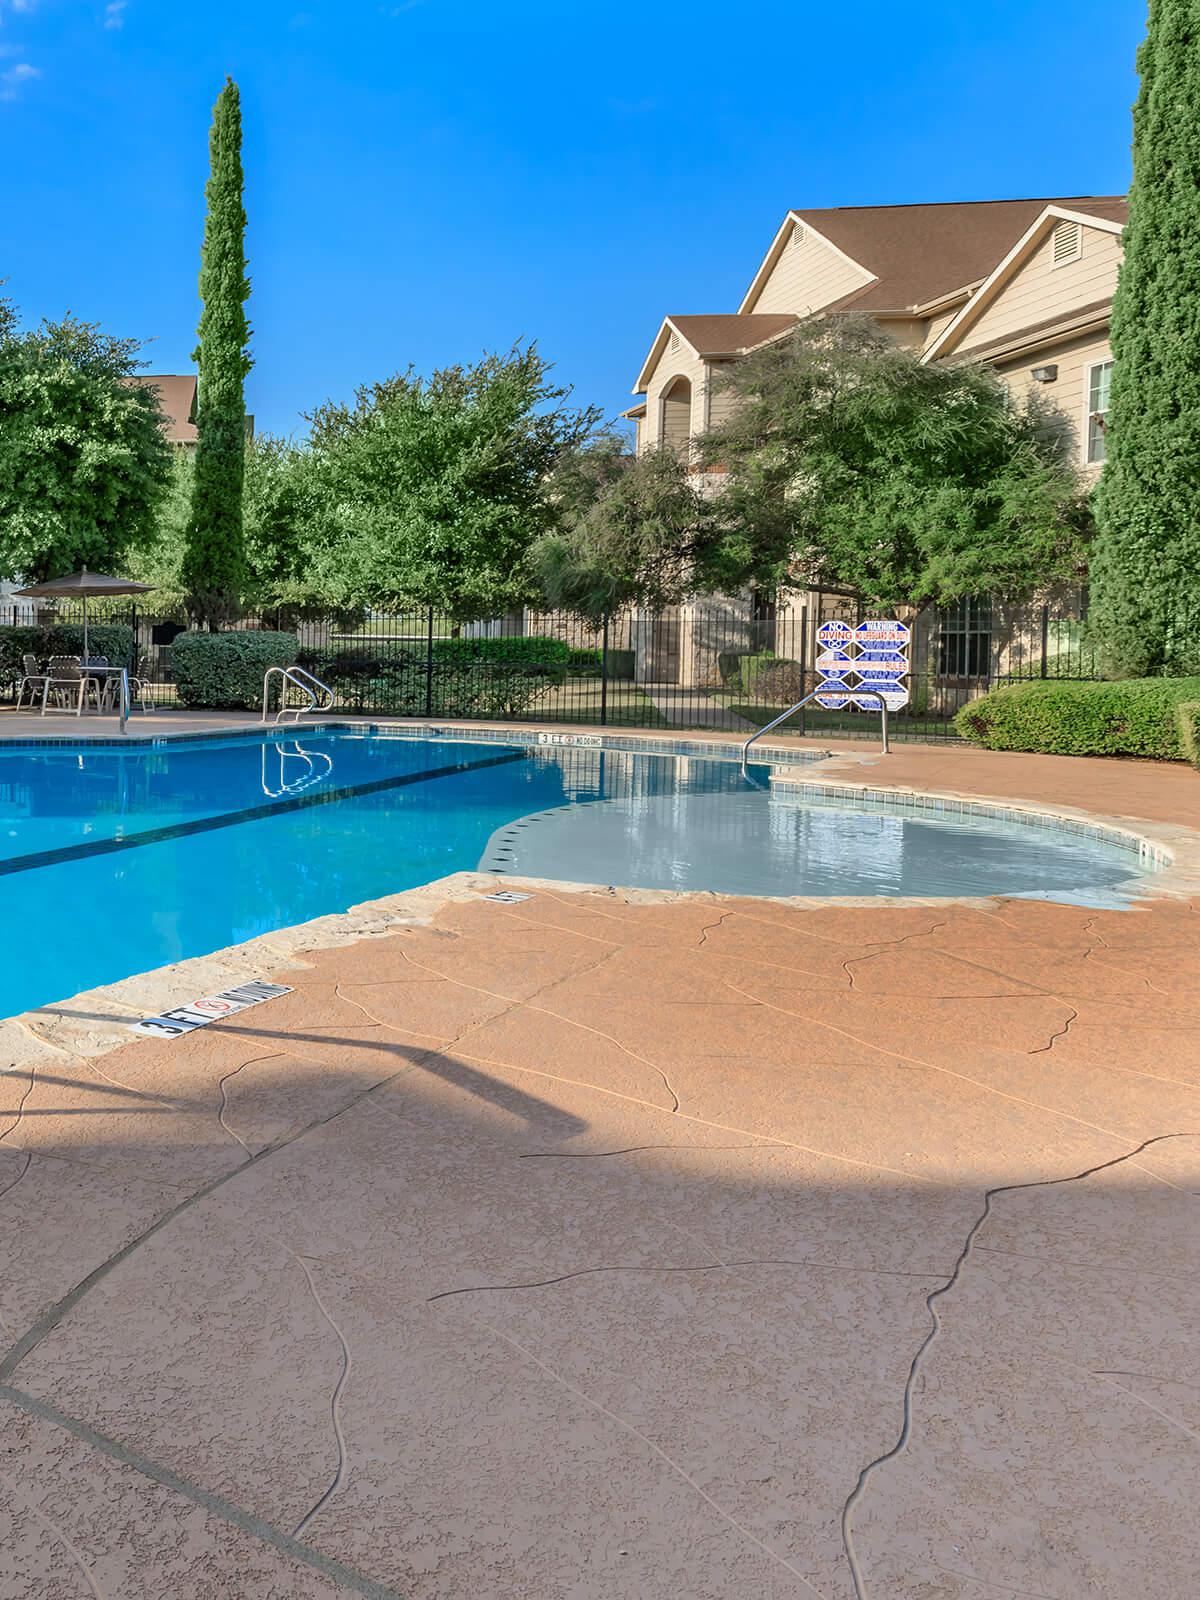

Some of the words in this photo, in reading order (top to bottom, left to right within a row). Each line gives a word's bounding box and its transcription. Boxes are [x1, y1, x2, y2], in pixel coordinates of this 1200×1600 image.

[829, 622, 843, 631] NO
[867, 622, 898, 631] WARNING
[819, 631, 853, 640] DIVING
[885, 662, 907, 671] RULES
[160, 1007, 215, 1027] FT
[140, 1021, 184, 1035] 3
